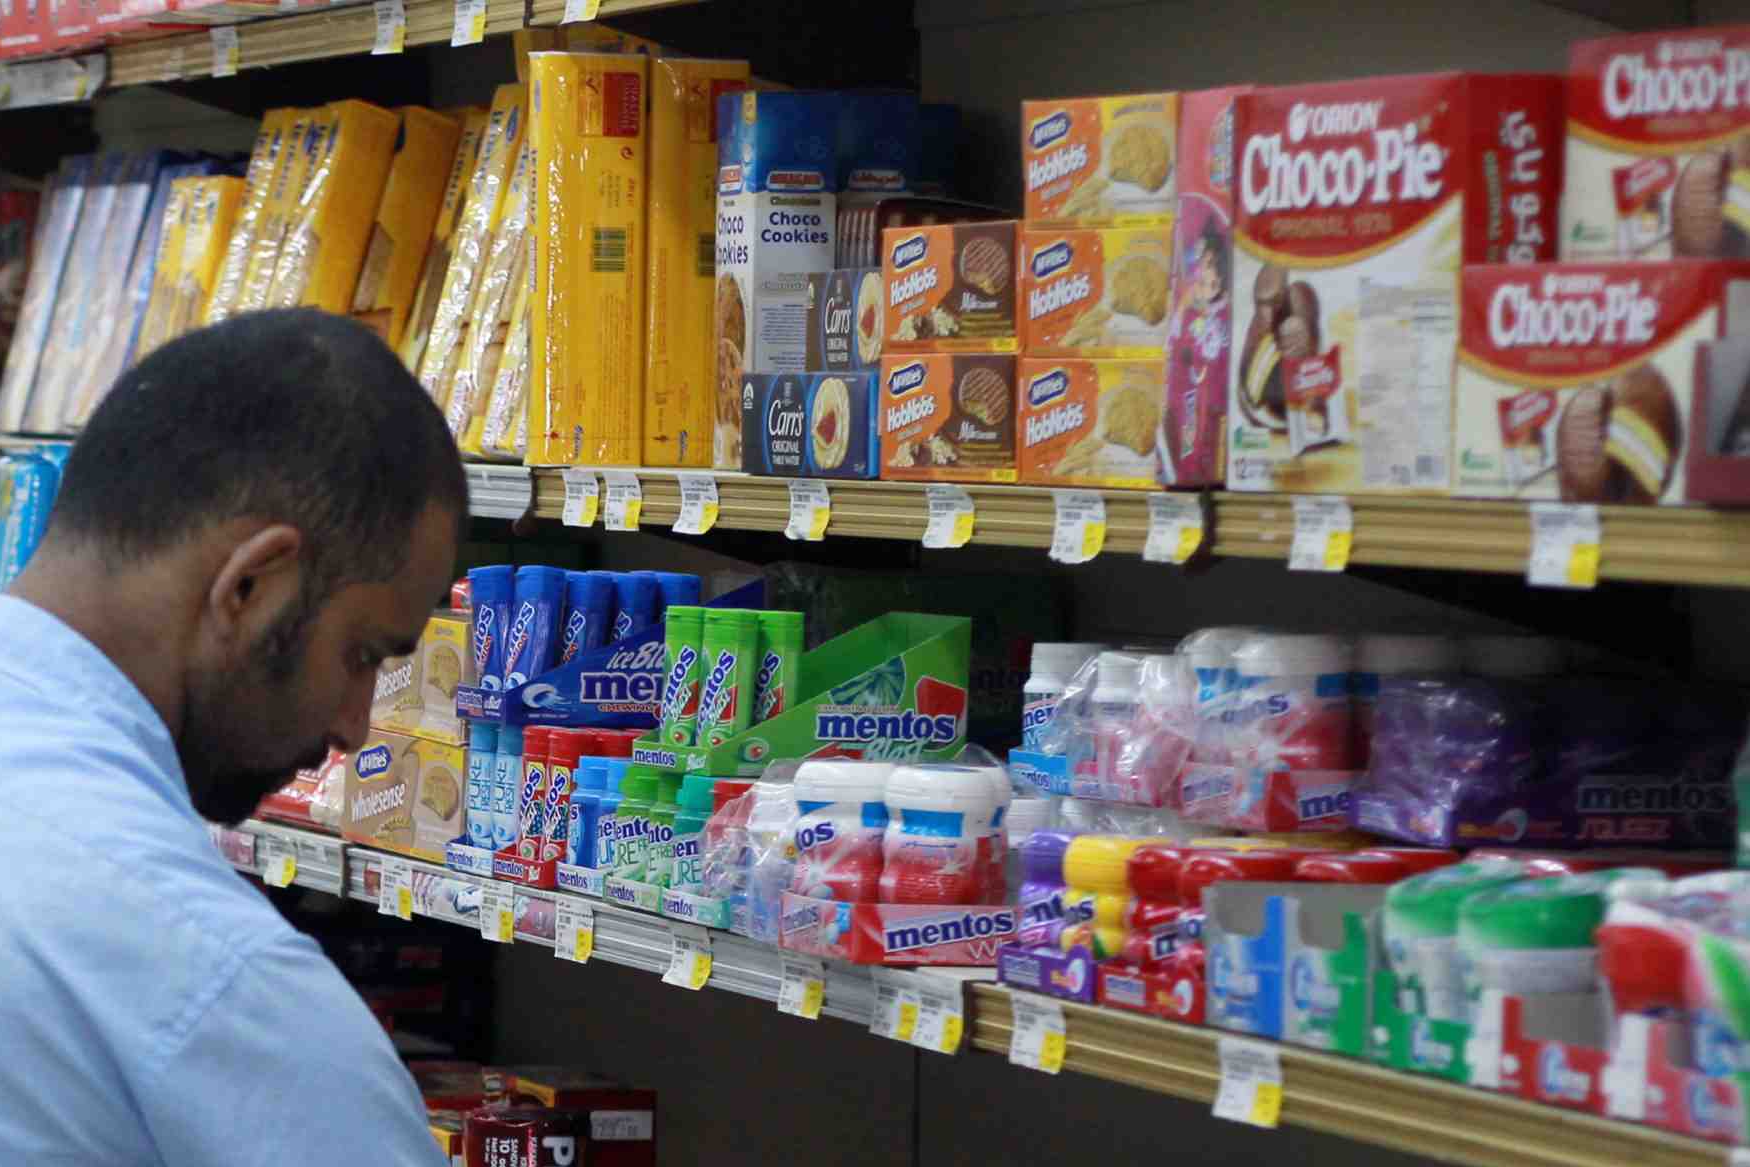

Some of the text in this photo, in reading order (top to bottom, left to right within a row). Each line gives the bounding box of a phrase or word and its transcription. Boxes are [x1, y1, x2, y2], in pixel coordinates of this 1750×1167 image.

[1312, 100, 1385, 137] ORION
[768, 210, 821, 227] Choco
[760, 228, 829, 245] Cookies
[767, 400, 804, 437] Carr's
[815, 708, 958, 742] mentos
[633, 749, 676, 767] mentos
[468, 757, 483, 811] PURE
[494, 859, 523, 877] mentos
[558, 869, 588, 889] mentos
[883, 911, 1014, 951] mentos
[499, 1138, 510, 1154] 10
